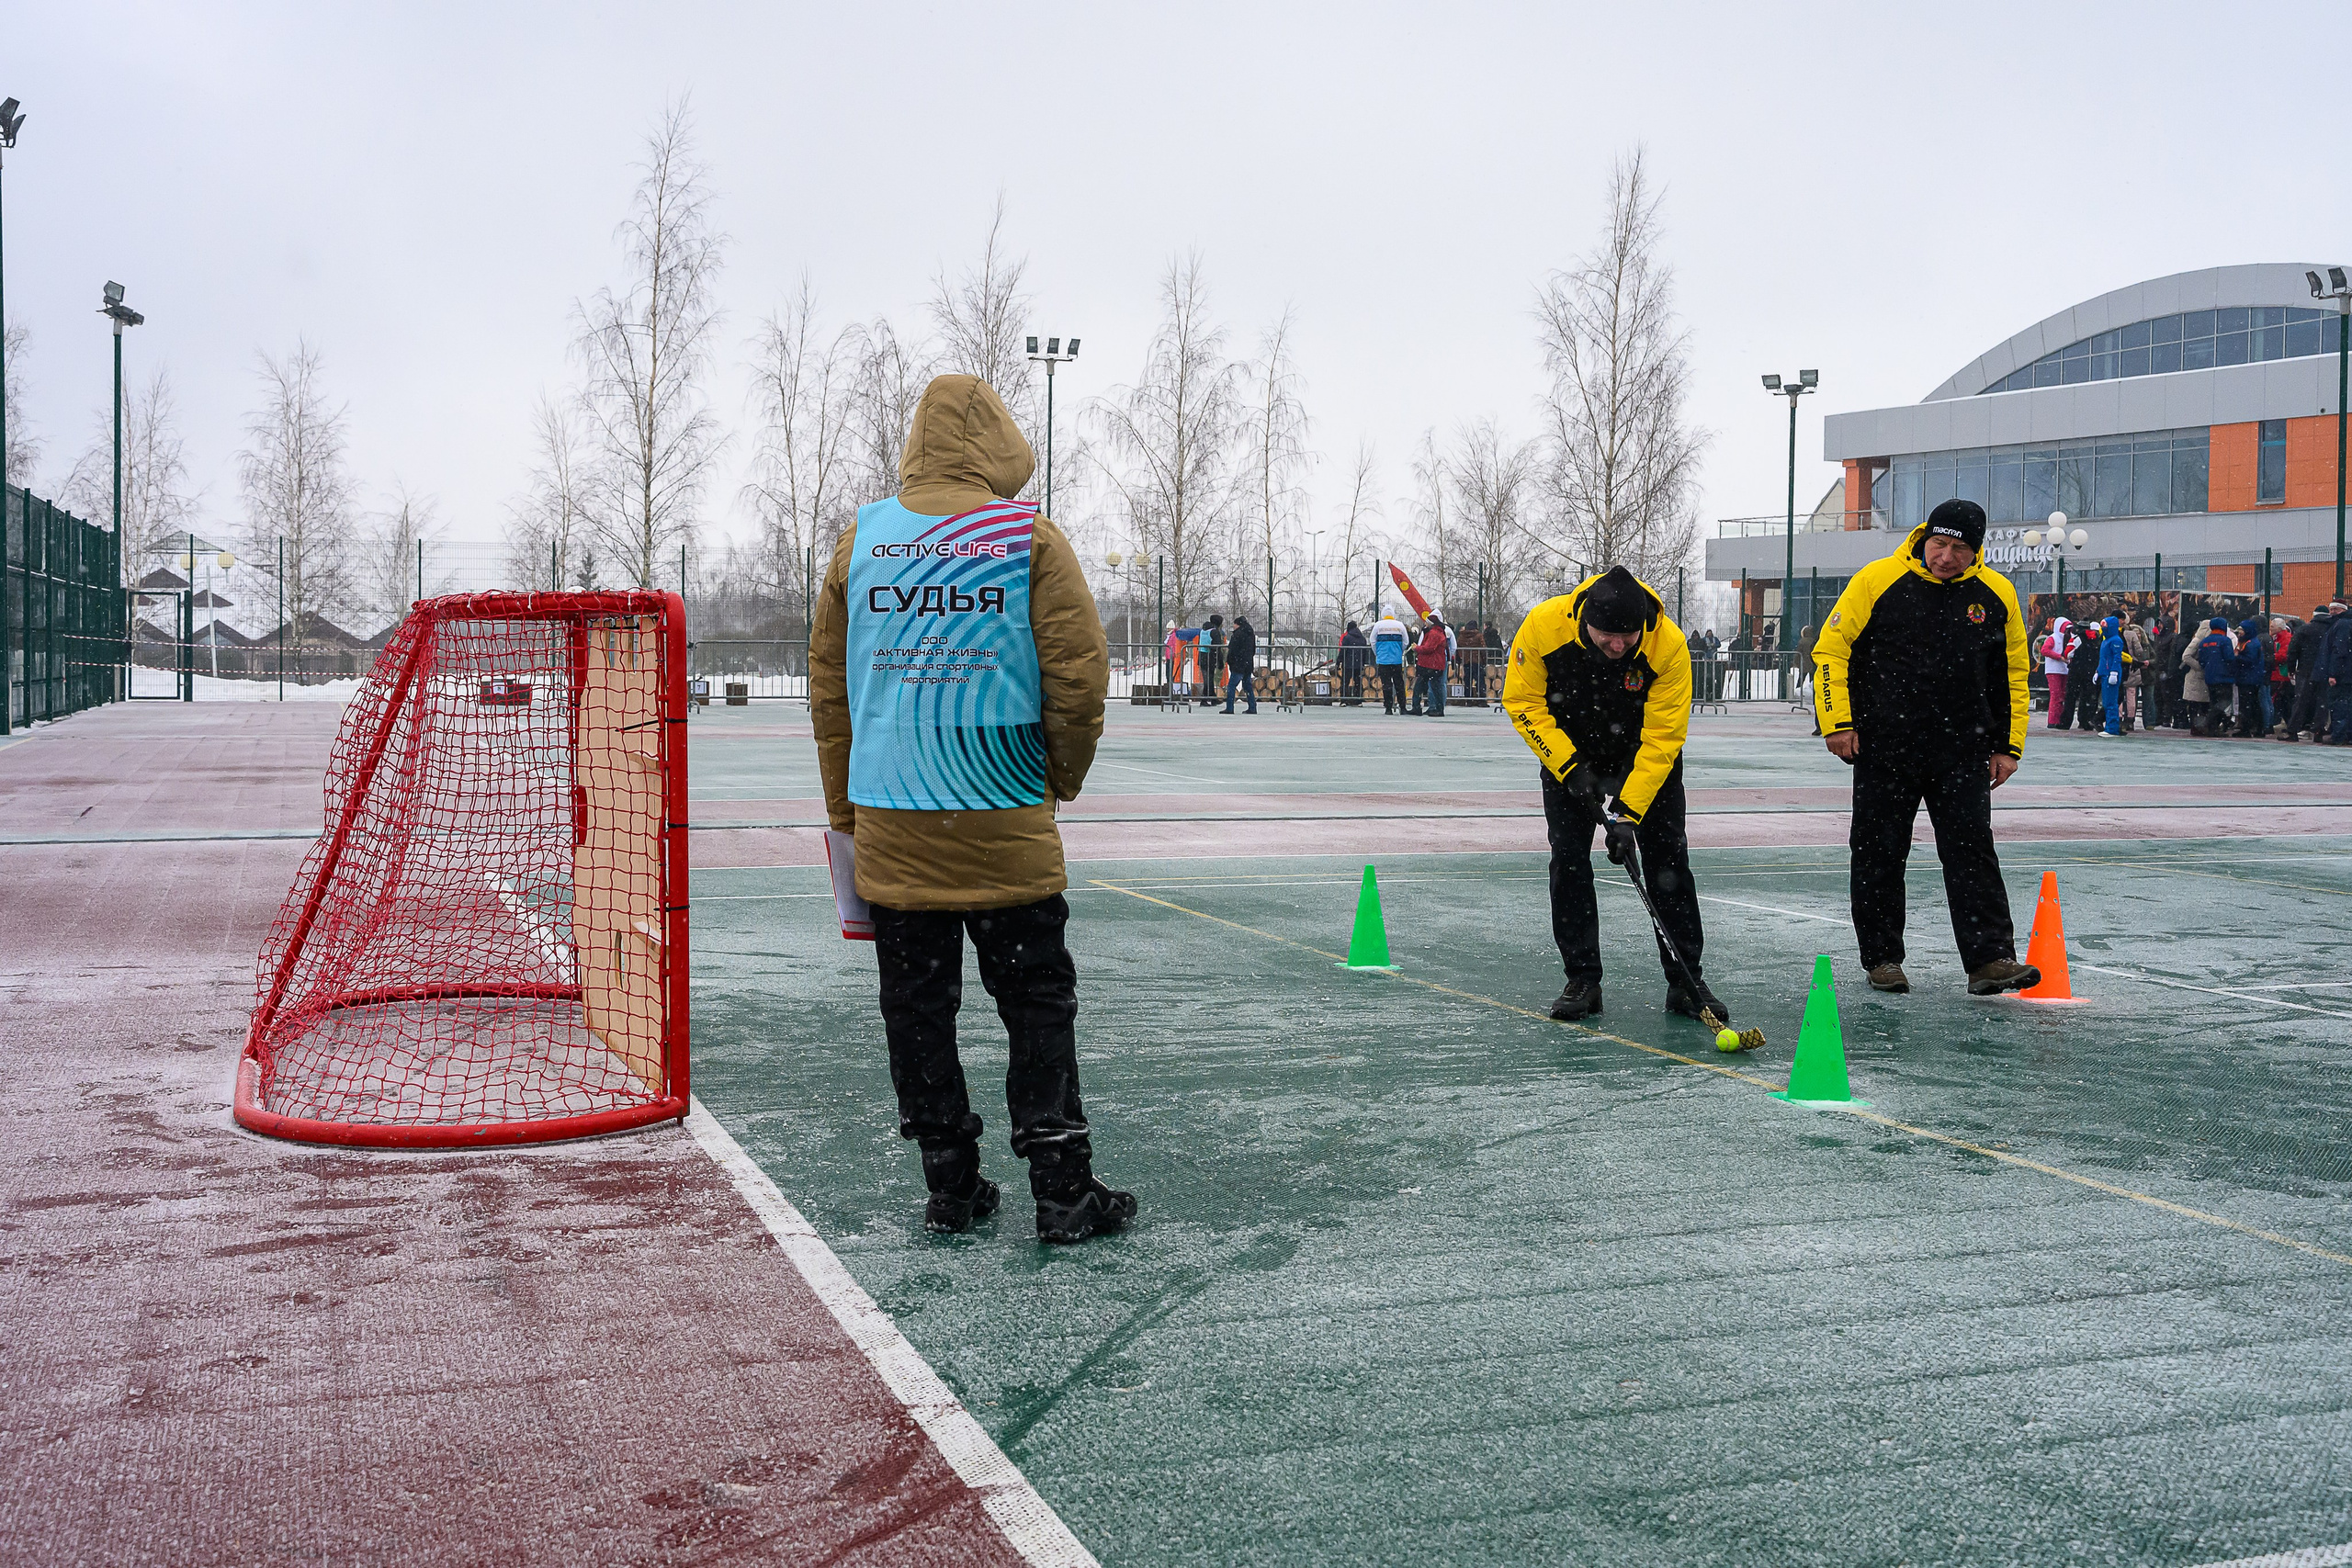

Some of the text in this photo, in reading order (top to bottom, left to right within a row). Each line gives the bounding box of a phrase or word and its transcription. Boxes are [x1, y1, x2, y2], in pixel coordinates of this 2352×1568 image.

[1984, 527, 2030, 542] КАФЕ
[955, 542, 1006, 558] LIFE
[868, 585, 1005, 617] СУДЬЯ
[922, 636, 948, 645] ООО
[873, 649, 999, 658] «АКТИВНАЯ ЖИЗНЬ»
[872, 663, 999, 672] организация спортивных
[901, 675, 970, 685] мероприятий
